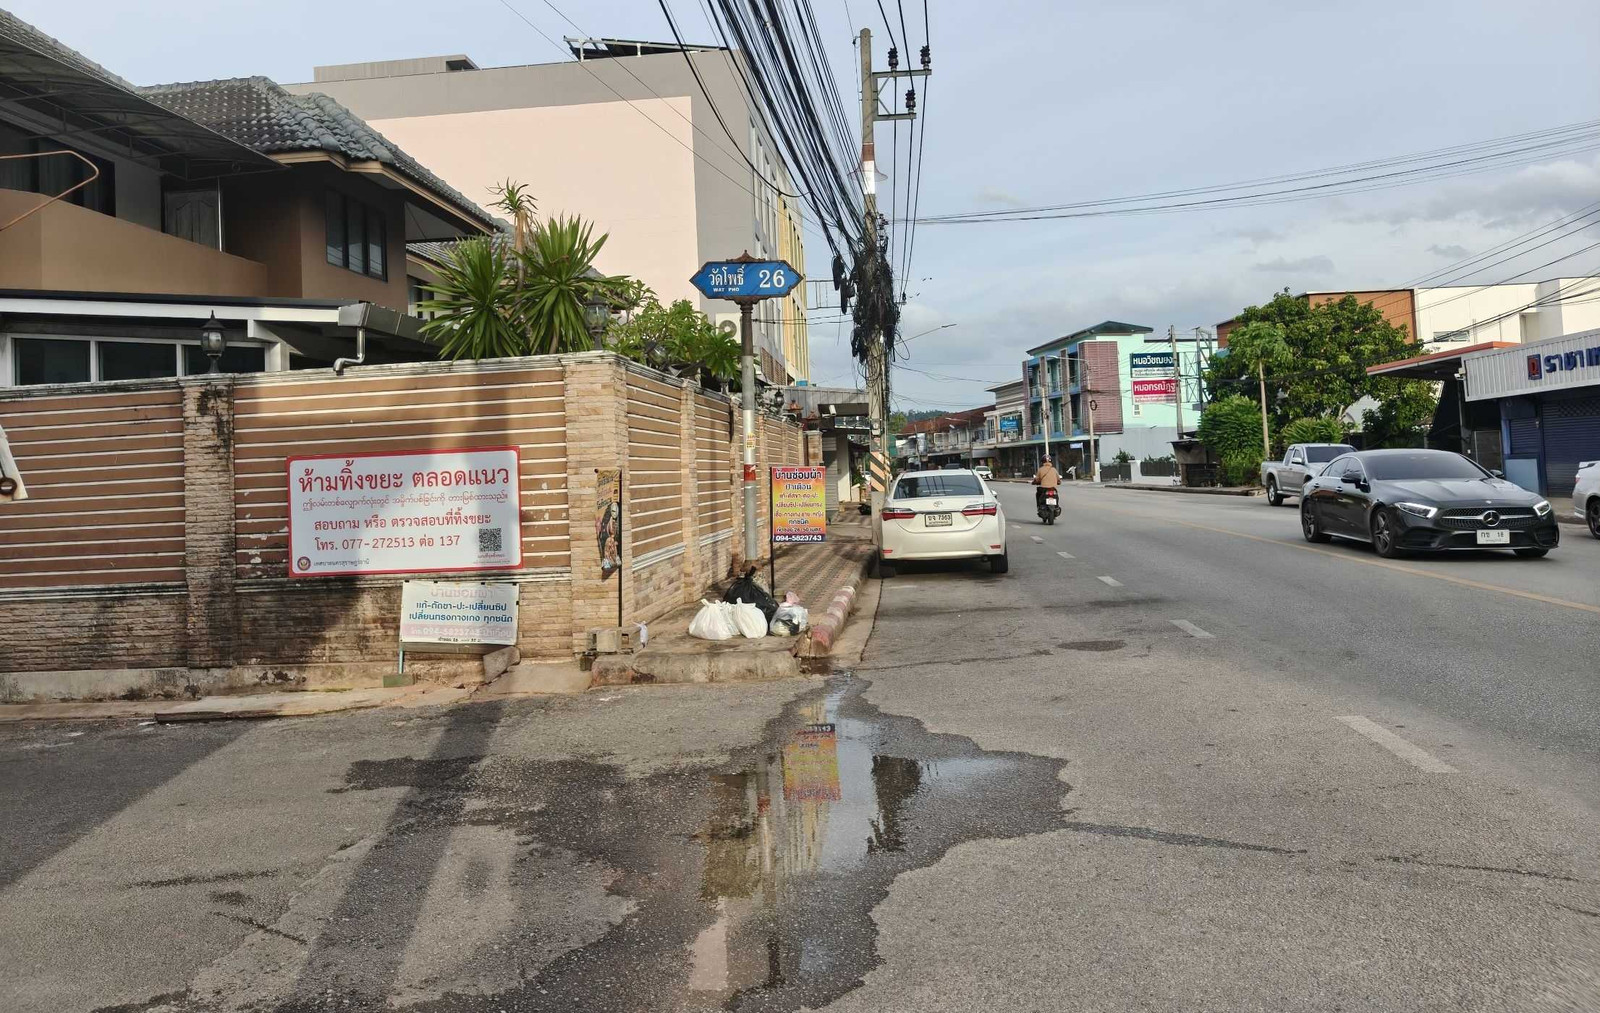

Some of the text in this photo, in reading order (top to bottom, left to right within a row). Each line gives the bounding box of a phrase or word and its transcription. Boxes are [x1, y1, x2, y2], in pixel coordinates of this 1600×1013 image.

[708, 264, 785, 288] วัดโพธิ์ 26
[298, 460, 510, 493] ห้ามทิ้งขยะ ตลอดแนว
[314, 507, 491, 531] สอบถาม หรือ ตรวจสอบที่ทิ้งขยะ
[314, 534, 460, 551] โทร. 077-272513 ต่อ 137
[409, 610, 513, 624] เปลี่ยนทรงกางเกง ทุกชนิด
